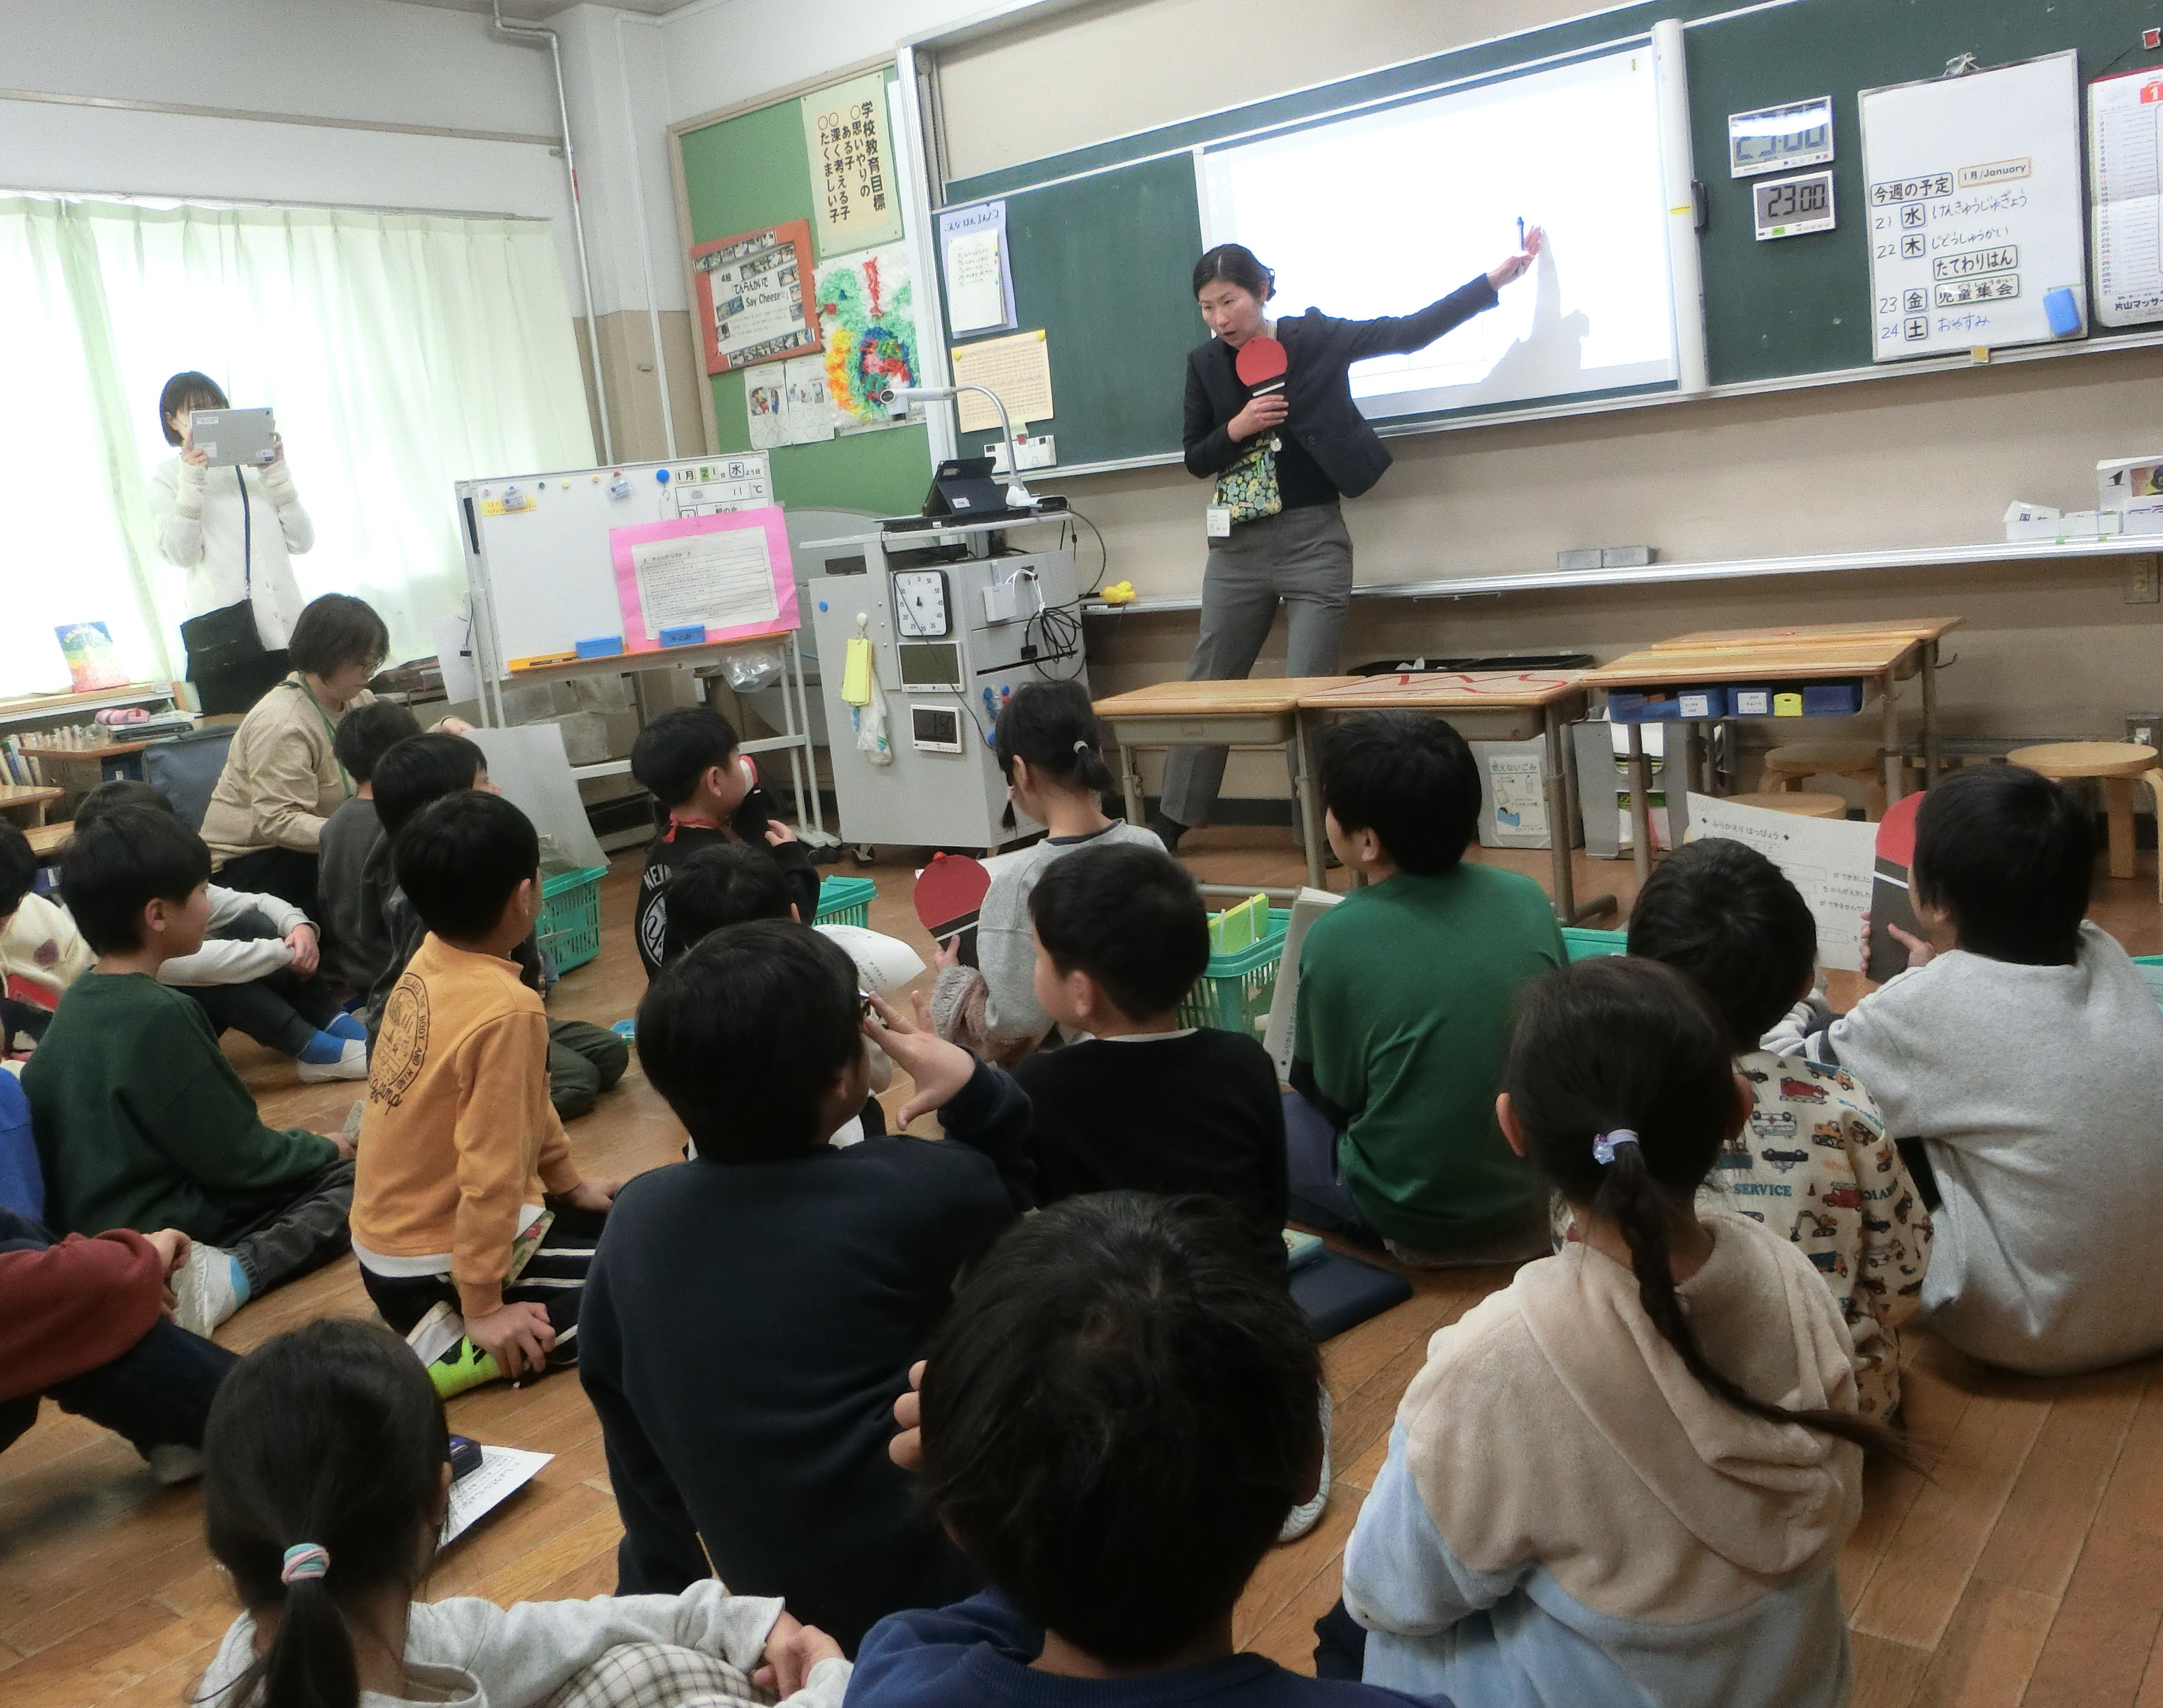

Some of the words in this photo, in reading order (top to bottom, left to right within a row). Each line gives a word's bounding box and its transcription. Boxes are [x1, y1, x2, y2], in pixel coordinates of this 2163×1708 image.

[843, 125, 855, 171] ある子
[862, 101, 885, 211] 学校教育目標
[1874, 177, 1949, 202] 今週の予定
[1875, 217, 1891, 229] 21
[1904, 207, 1922, 224] 水
[1932, 188, 2028, 219] けんきゅうじゅぎょう
[1877, 245, 1895, 258] 22
[1905, 238, 1922, 254] 木
[1936, 250, 2012, 277] たてわりはん
[746, 297, 757, 307] Say
[1880, 297, 1898, 313] 23
[1906, 292, 1923, 309] 金
[1938, 283, 2013, 303] 児童集会
[1881, 324, 1899, 339] 24
[1909, 320, 1924, 337] 土
[1938, 312, 1990, 332] おやすみ
[412, 1047, 422, 1066] AND
[1734, 1183, 1792, 1197] SERVICE
